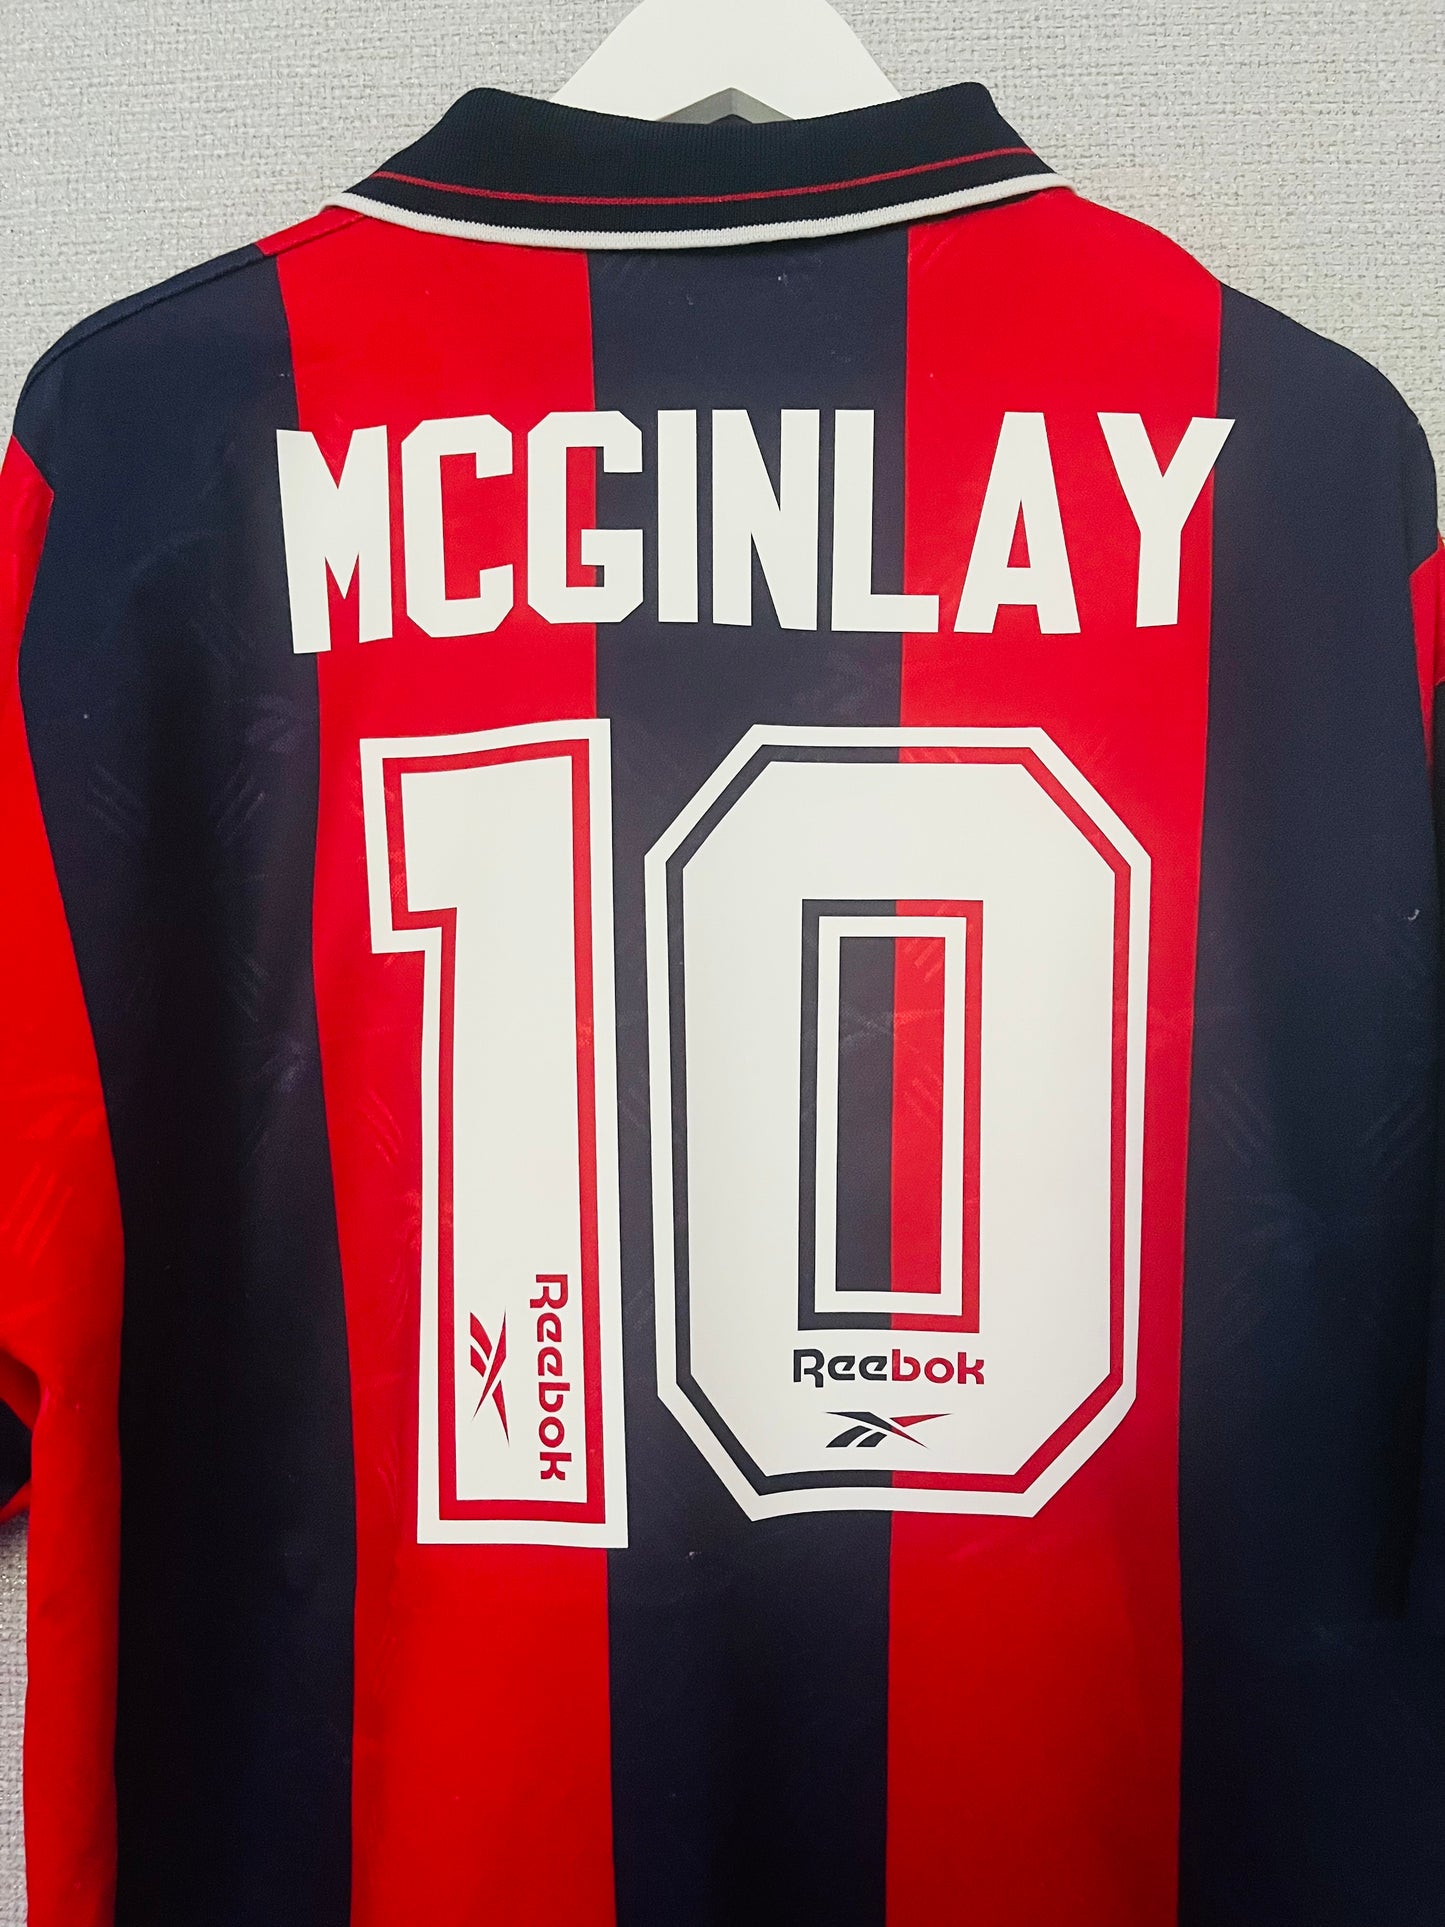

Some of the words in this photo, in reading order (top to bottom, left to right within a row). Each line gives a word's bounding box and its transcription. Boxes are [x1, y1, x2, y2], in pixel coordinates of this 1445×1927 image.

[275, 408, 1236, 654] MCGINLAY
[359, 718, 1152, 1549] 10
[529, 1274, 572, 1482] Reebok
[792, 1348, 985, 1389] Reebok
